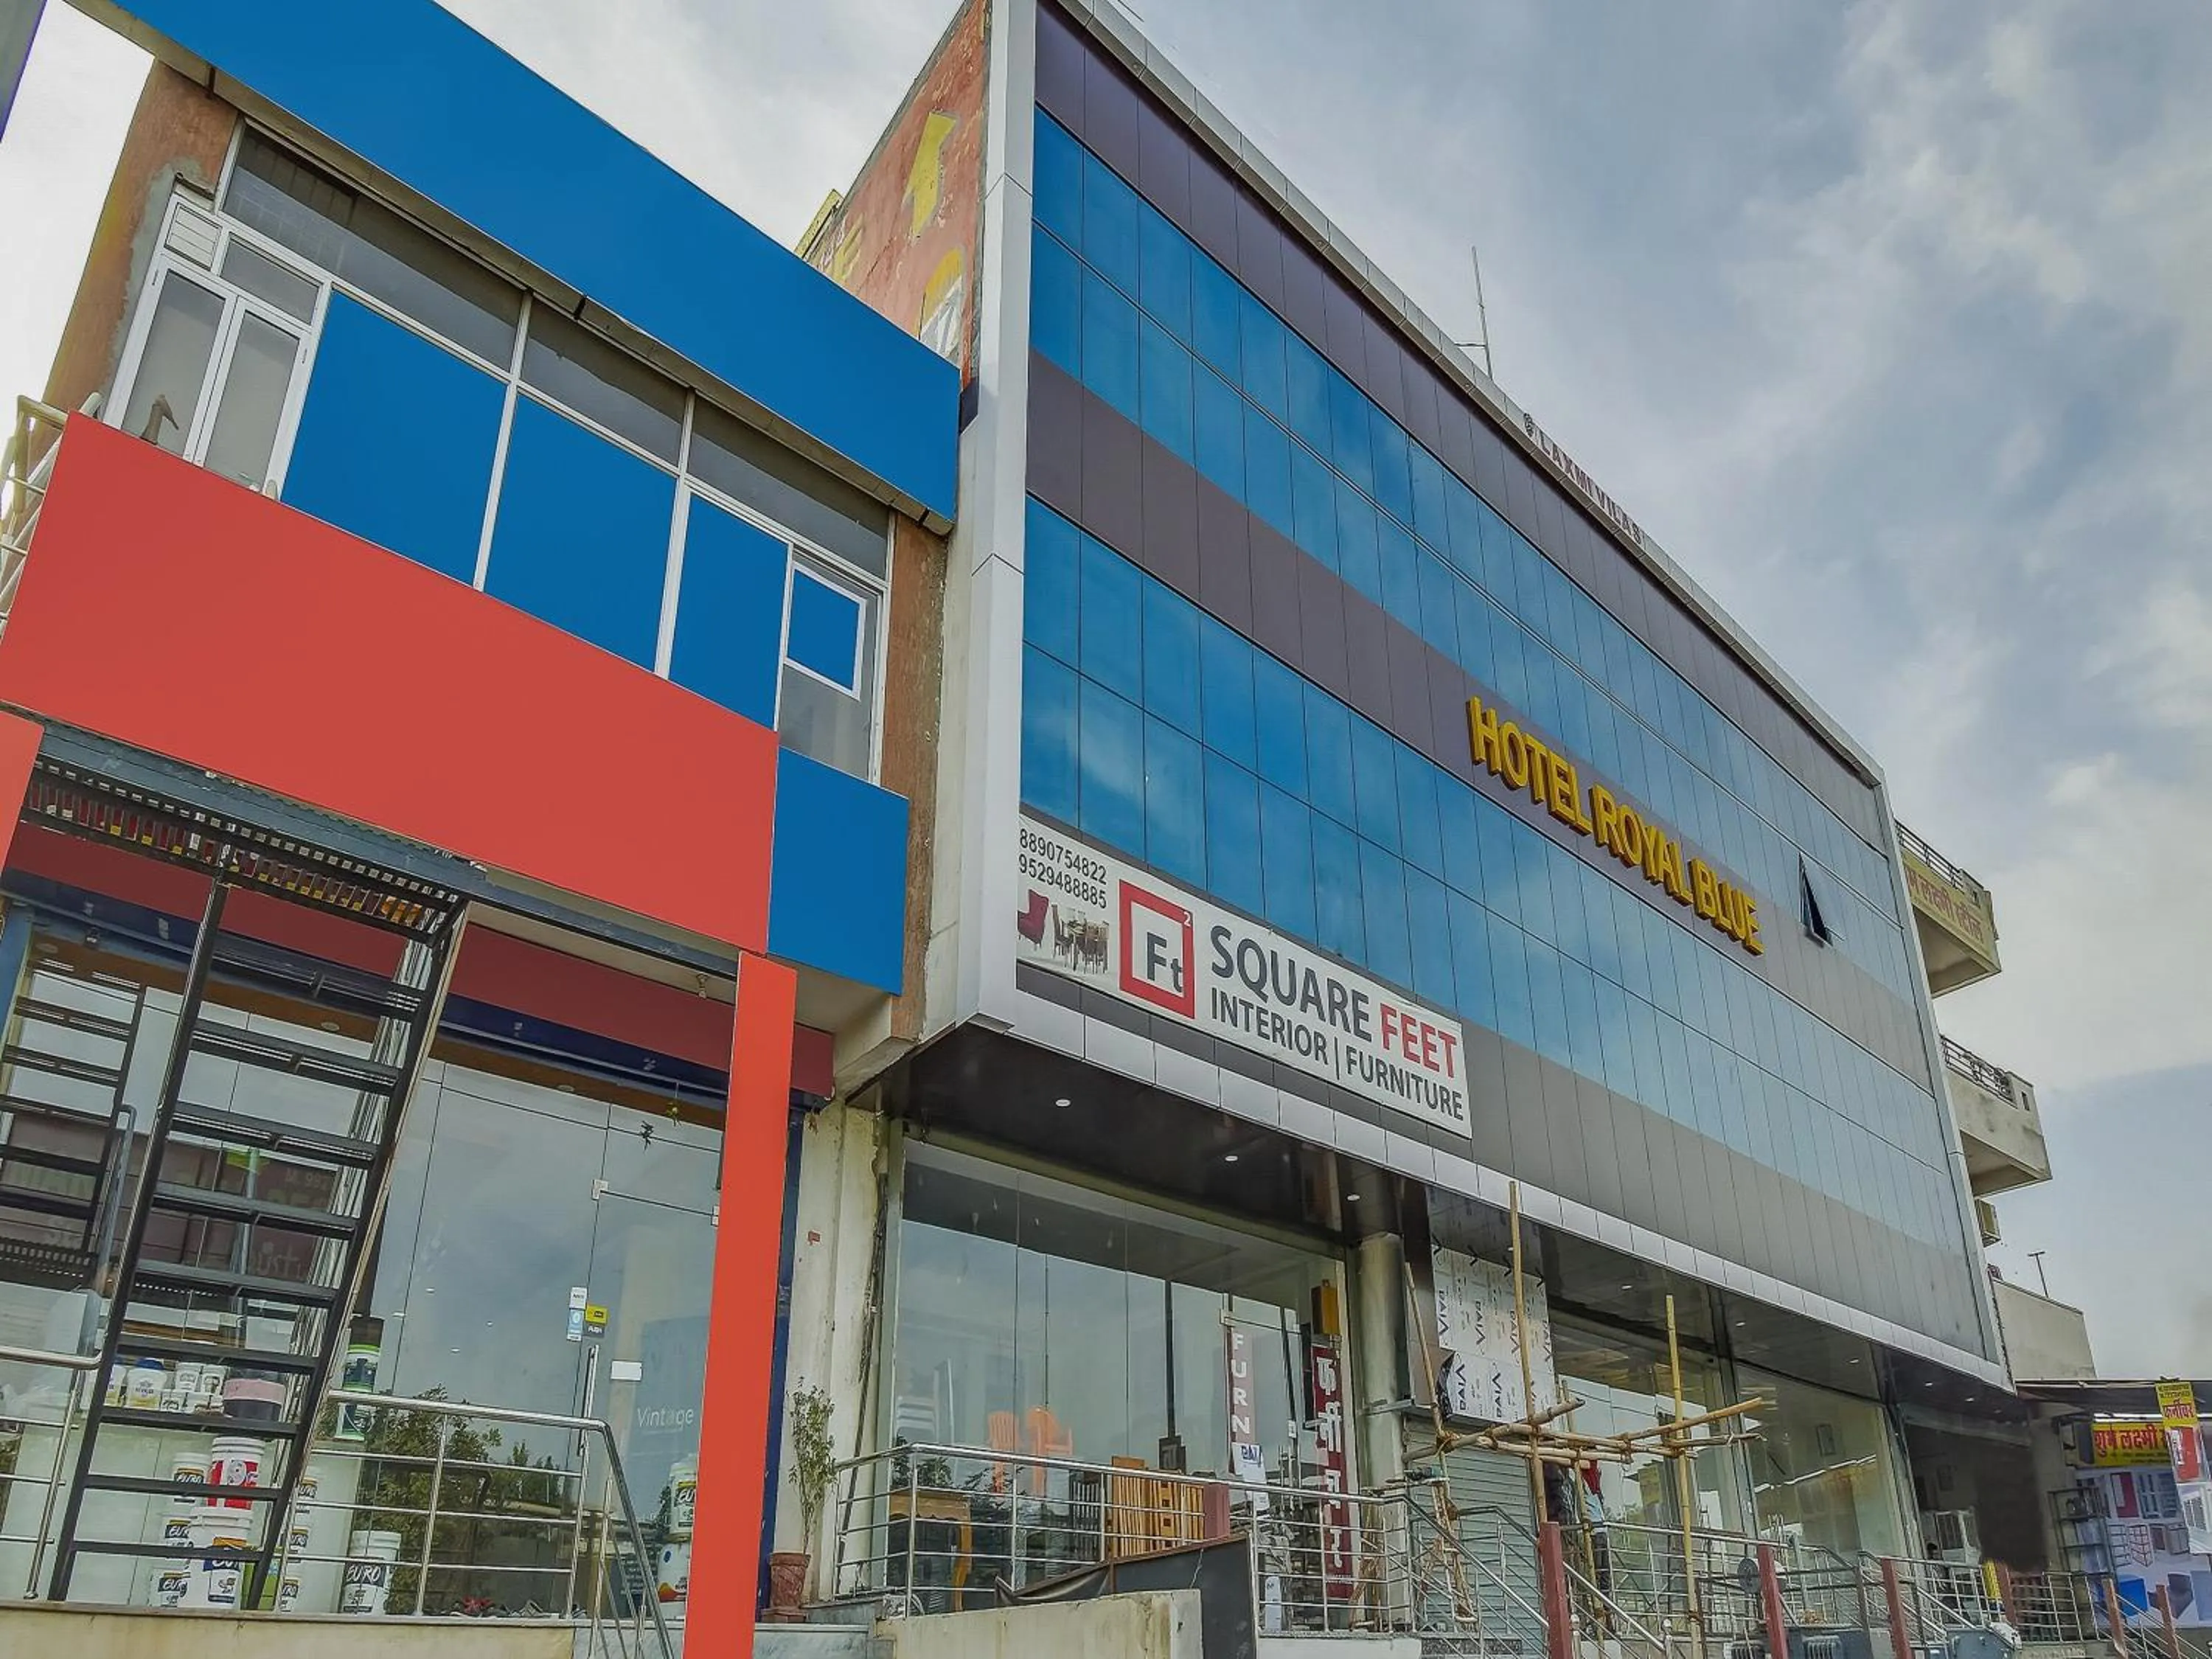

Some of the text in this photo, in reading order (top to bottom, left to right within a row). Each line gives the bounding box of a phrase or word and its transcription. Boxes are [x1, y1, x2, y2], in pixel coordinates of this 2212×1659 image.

[1466, 695, 1764, 956] HOTEL ROYAL BLUE
[1018, 853, 1107, 909] 9529488885
[1019, 828, 1107, 886] 8890754822
[1147, 911, 1192, 993] Ft 2
[1210, 924, 1457, 1079] SQUARE FEET
[1211, 987, 1464, 1121] INTERIOR FURNITURE
[637, 1406, 695, 1430] Vintage
[678, 1489, 697, 1503] EU
[346, 1564, 382, 1582] EURO
